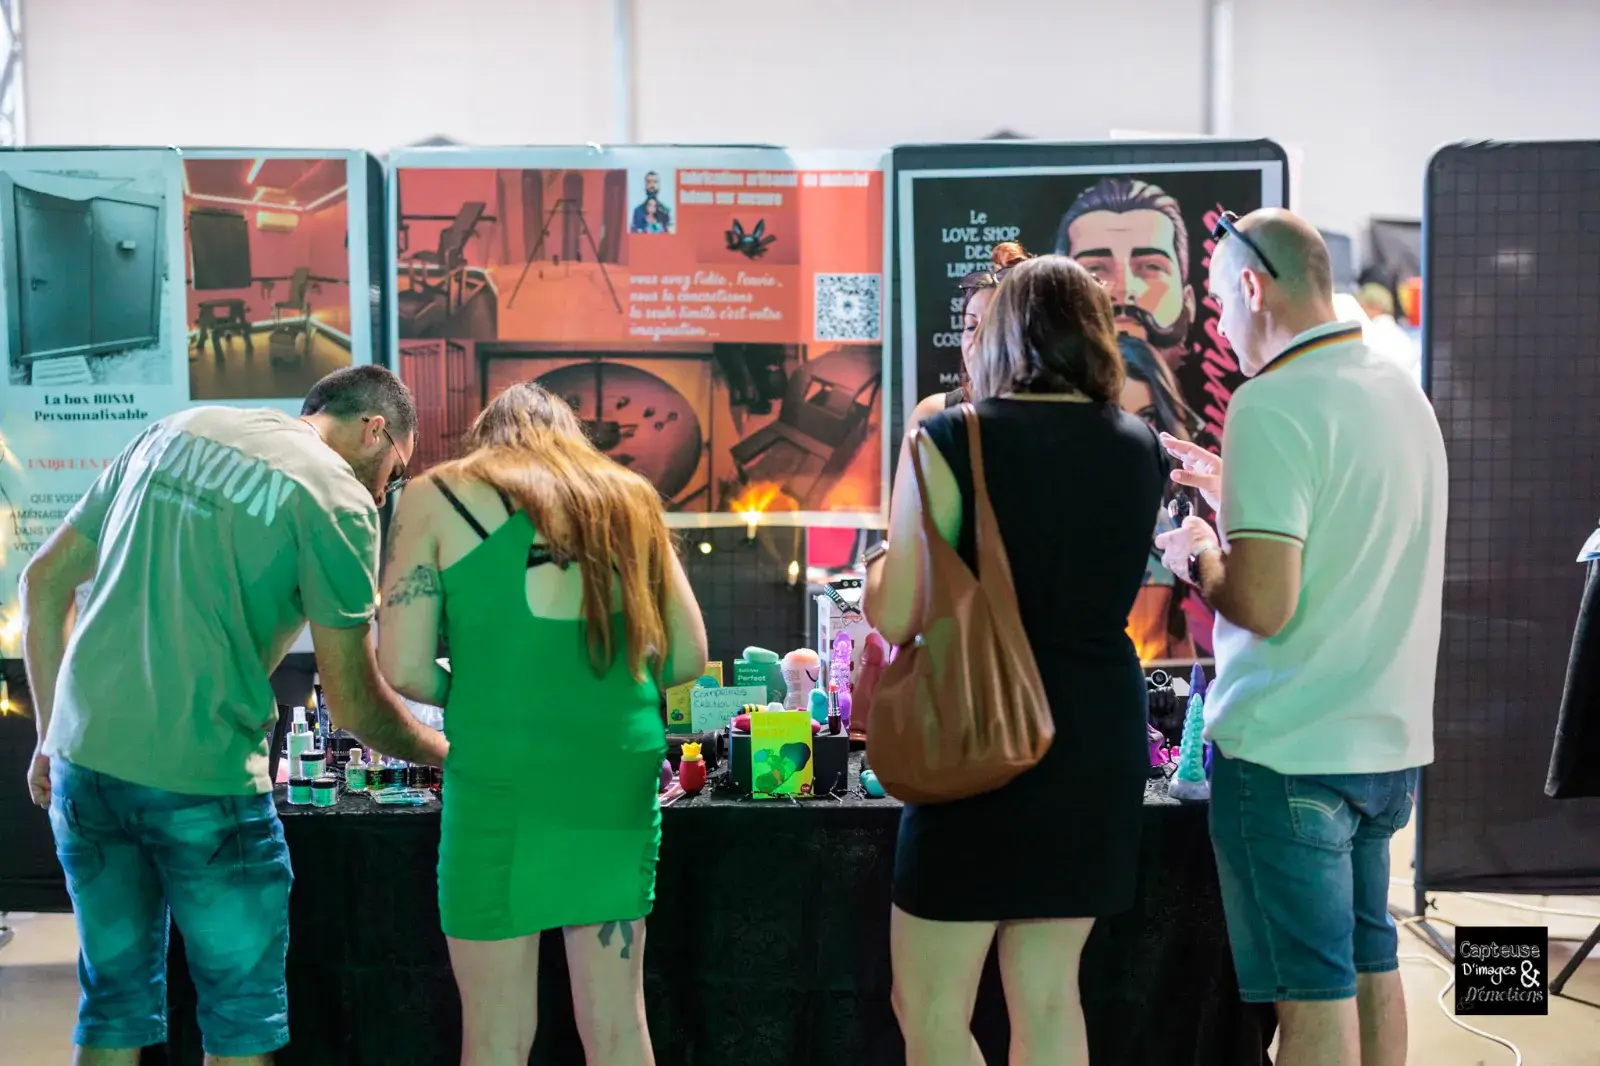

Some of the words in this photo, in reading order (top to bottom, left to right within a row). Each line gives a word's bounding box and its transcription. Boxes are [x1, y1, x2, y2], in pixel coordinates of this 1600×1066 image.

[942, 227, 980, 243] LOVE
[982, 225, 1020, 242] SHOP
[965, 244, 992, 260] DES
[44, 394, 60, 405] La
[64, 393, 89, 404] box
[34, 408, 148, 421] Personnalisable
[54, 493, 83, 504] VOU
[737, 674, 766, 682] Perfect
